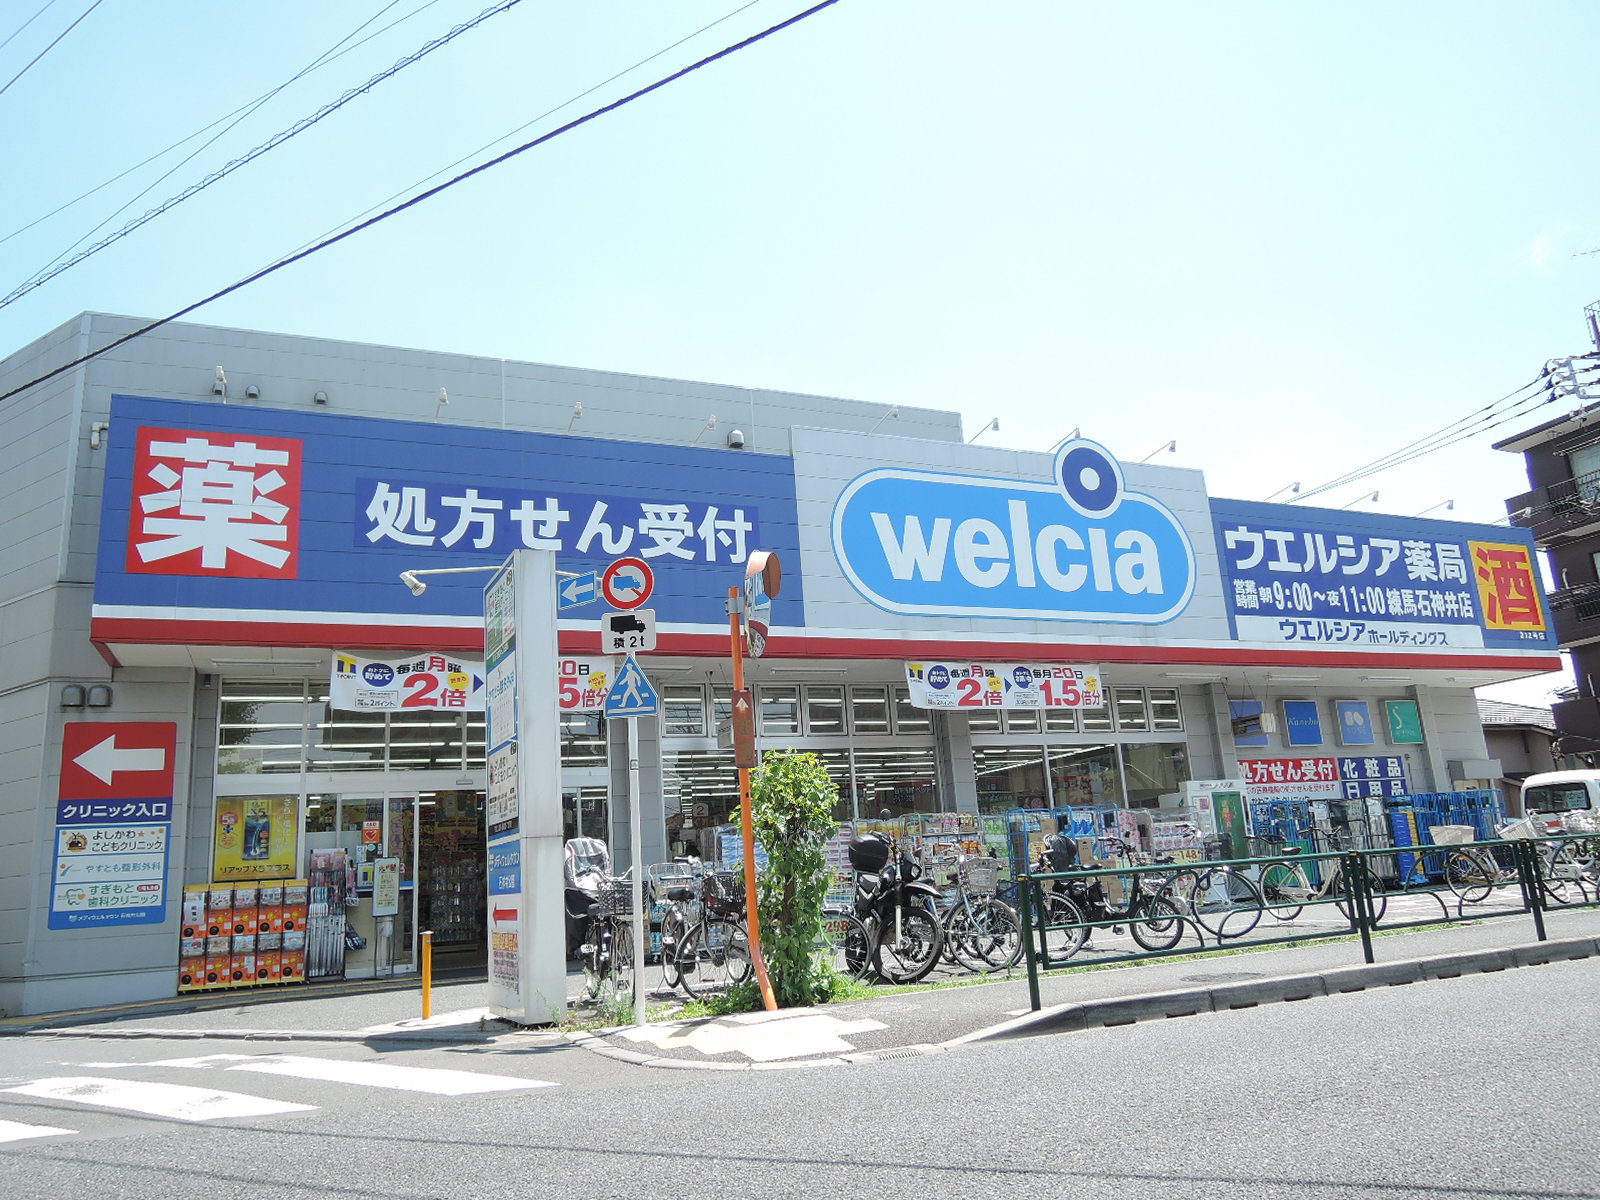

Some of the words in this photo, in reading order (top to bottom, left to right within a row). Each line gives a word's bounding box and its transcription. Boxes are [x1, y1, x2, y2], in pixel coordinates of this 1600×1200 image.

[136, 438, 290, 568] 薬
[366, 482, 753, 564] 処方せん受付
[870, 500, 1164, 595] welcia
[1224, 526, 1467, 585] ウエルシア薬局
[1476, 546, 1541, 625] 酒
[396, 656, 462, 674] 毎週月曜
[559, 660, 590, 675] 0日
[951, 665, 995, 678] 毎週月曜
[1033, 667, 1084, 679] 毎月20日
[401, 673, 467, 708] 2倍
[957, 678, 1003, 707] 2倍
[1238, 760, 1334, 784] 処方せん受付
[1343, 758, 1401, 778] 化粧品
[63, 803, 168, 818] クリニック入口
[92, 830, 136, 840] よしかわ
[91, 841, 163, 852] こどもクリニック
[85, 861, 161, 873] やすとも整形外科
[89, 884, 134, 895] すぎもと
[87, 894, 159, 907] 歯科クリニック
